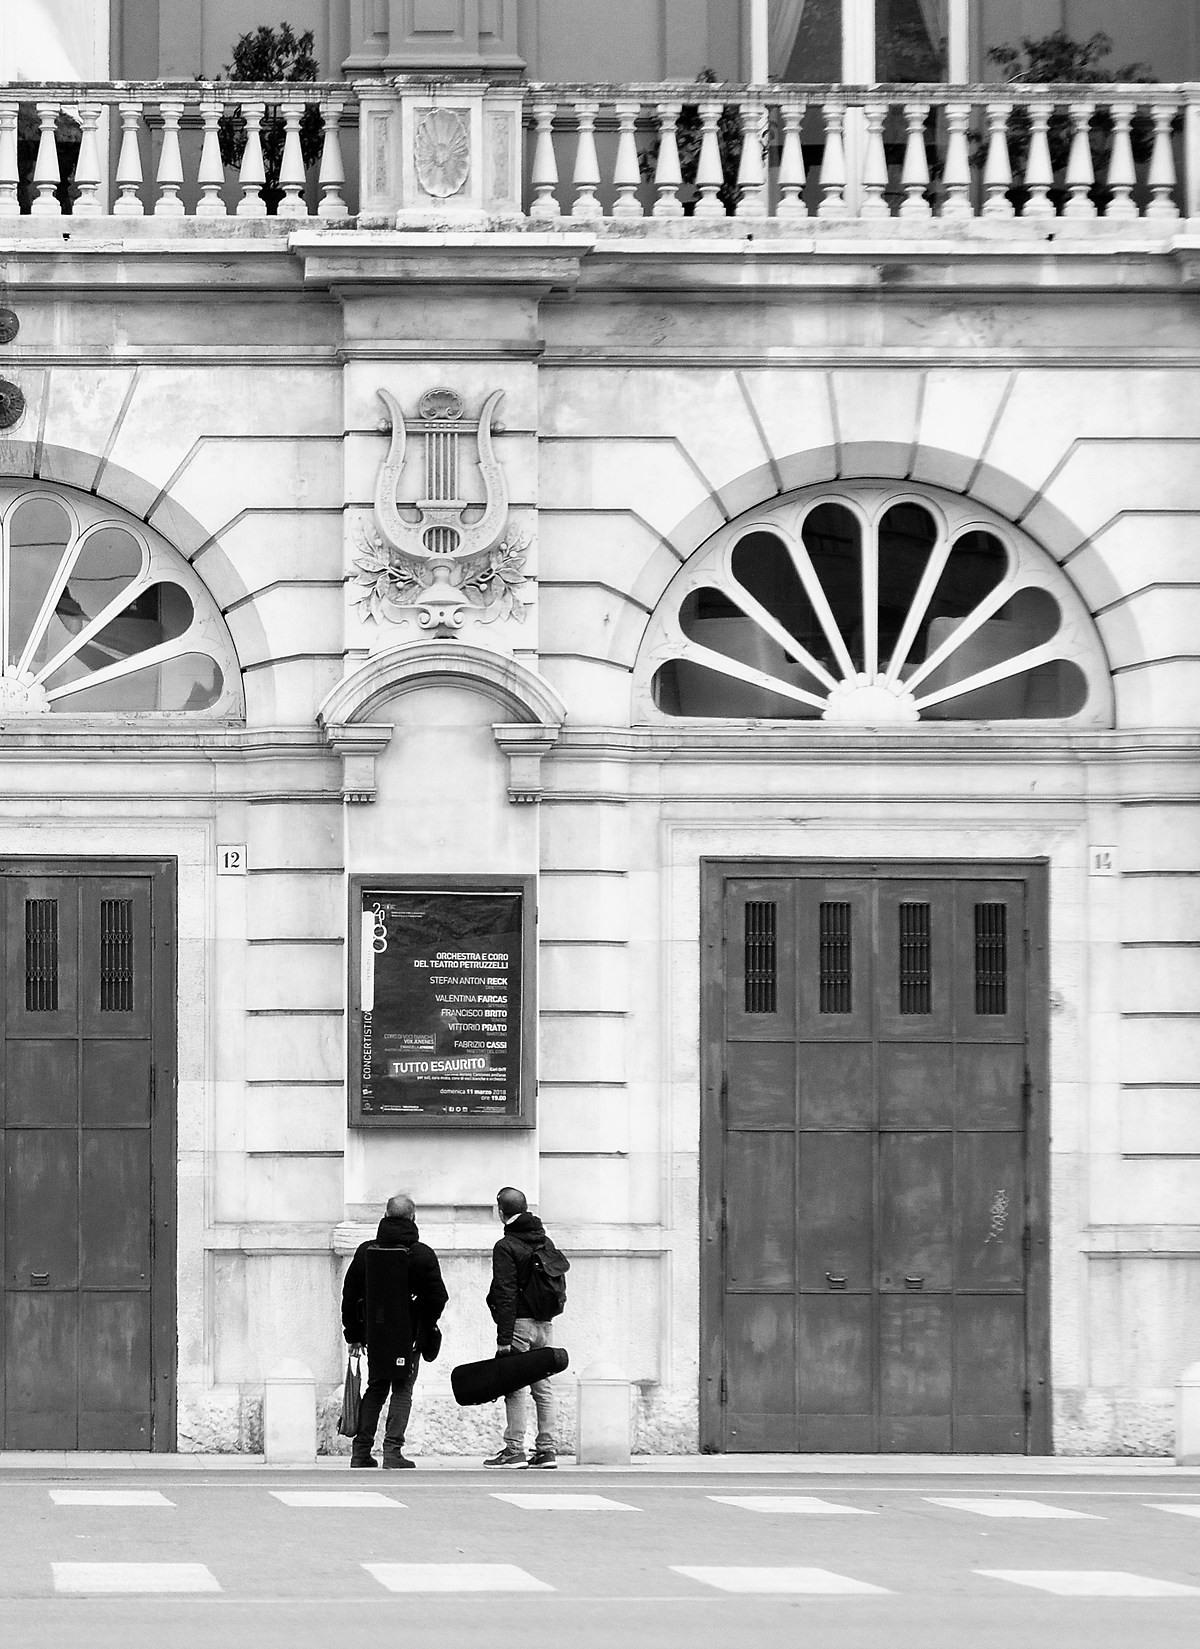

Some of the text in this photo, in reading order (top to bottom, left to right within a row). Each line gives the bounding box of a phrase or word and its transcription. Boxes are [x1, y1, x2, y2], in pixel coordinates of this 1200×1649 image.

[223, 851, 240, 868] 12
[1095, 852, 1111, 869] 14
[436, 952, 480, 960] ORCHESTRA
[488, 953, 509, 961] CORO
[414, 960, 509, 969] DEL TEATRO PETRUZZELLI
[429, 976, 508, 985] STEFAN ANTON RECK
[435, 994, 508, 1003] VALENTINA FARCAS
[441, 1008, 508, 1017] FRANCISCO BRITO
[448, 1023, 481, 1031] VITTORIO
[363, 1010, 372, 1080] CONCERTISTICA
[454, 1040, 485, 1048] FABRIZIO
[393, 1057, 486, 1073] TUTTO ESAURITO
